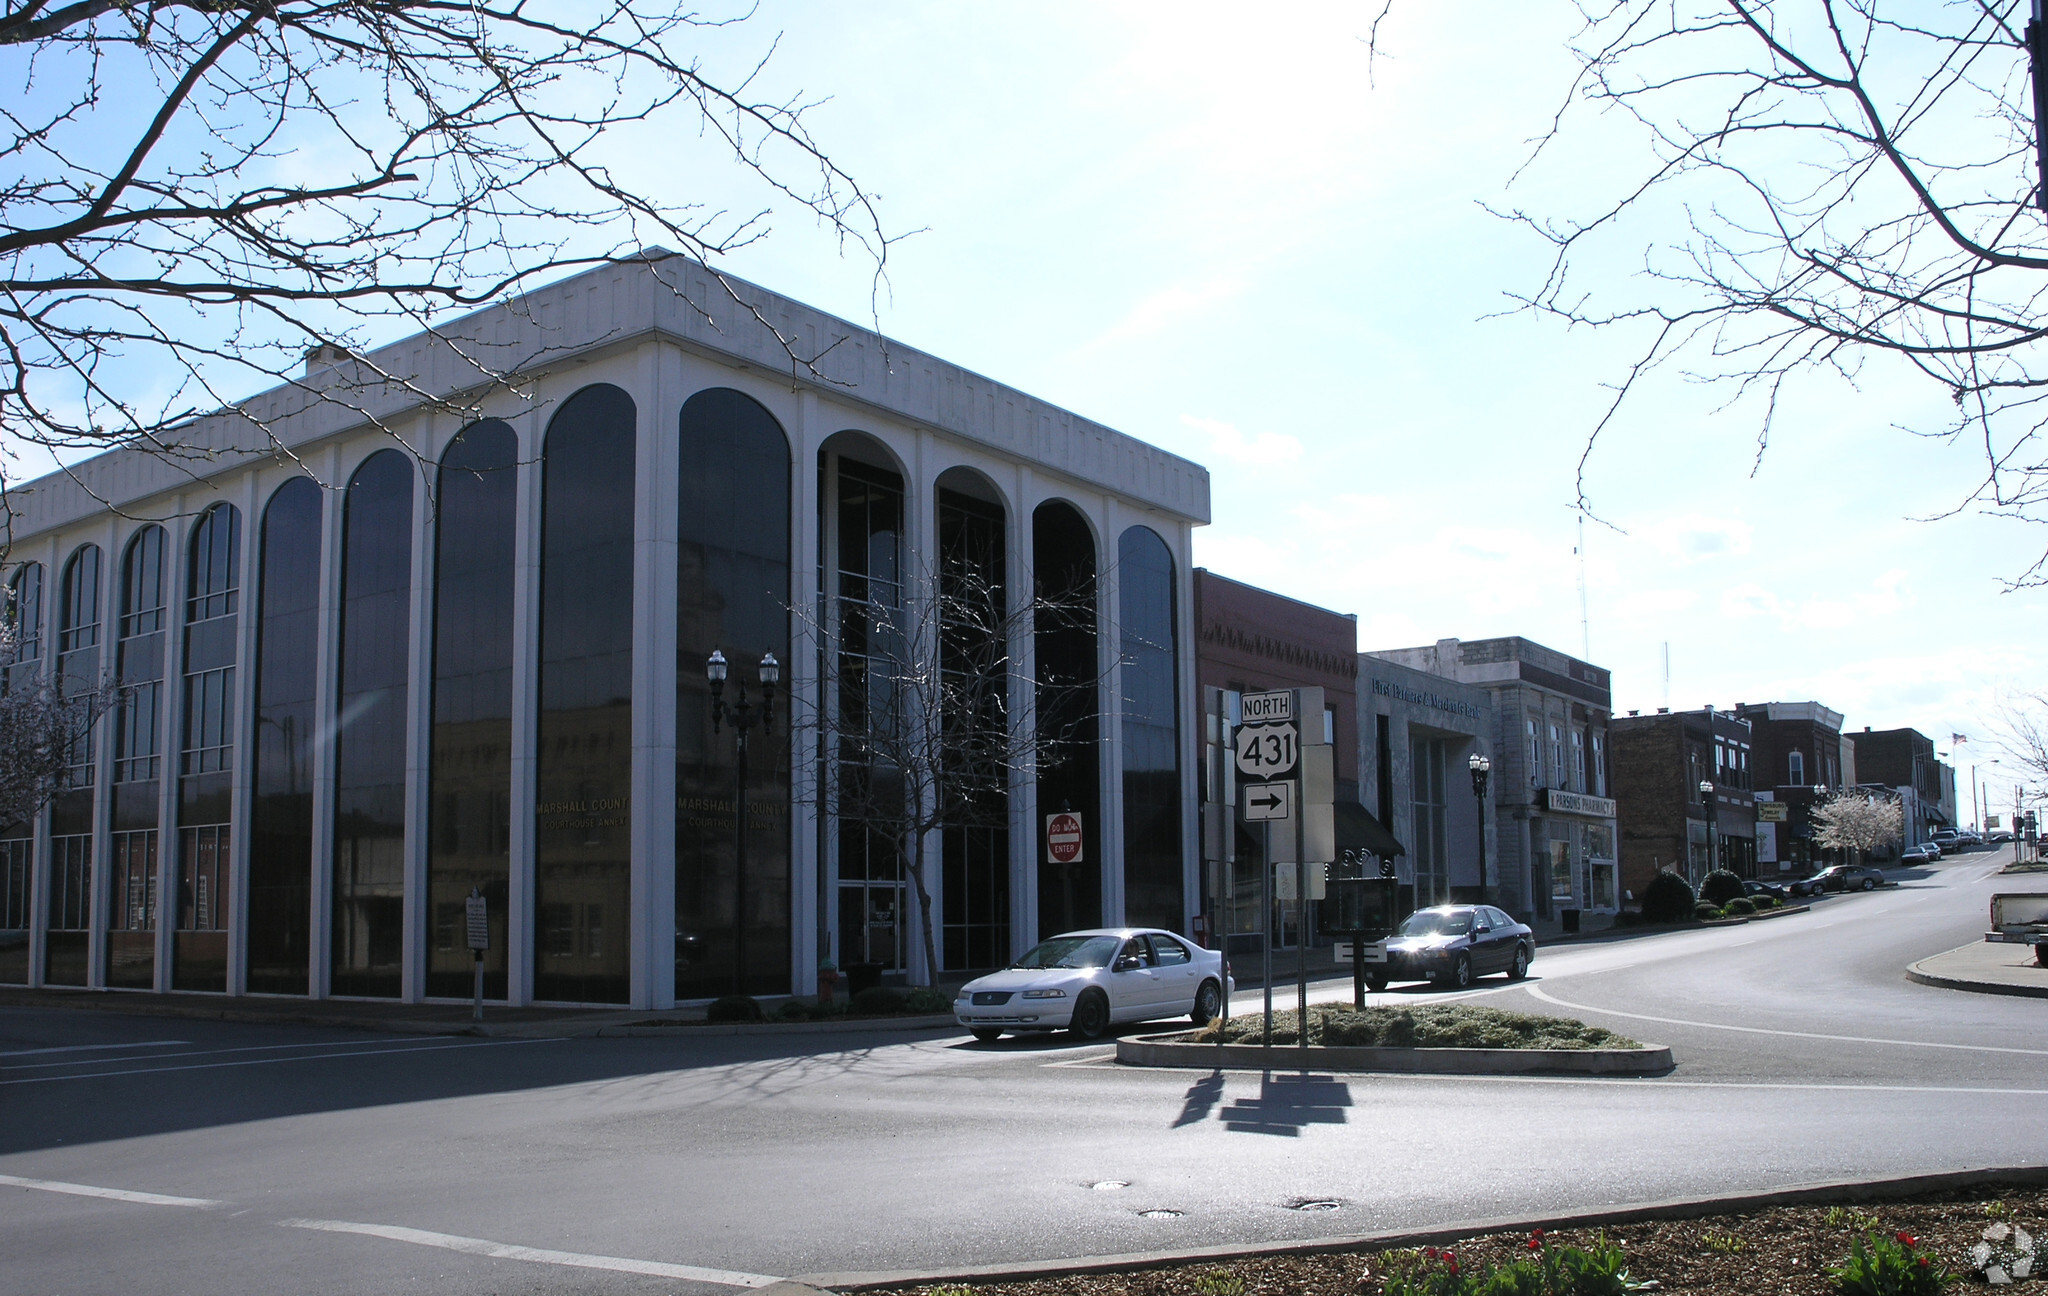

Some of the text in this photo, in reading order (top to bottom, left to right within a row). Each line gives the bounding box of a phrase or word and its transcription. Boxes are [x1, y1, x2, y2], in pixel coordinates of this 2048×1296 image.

[1244, 698, 1288, 715] NORTH
[1242, 733, 1290, 766] 431
[537, 801, 587, 815] MARSHALL
[677, 797, 738, 812] MARSHALL
[1556, 793, 1611, 815] PARSONS PHARMACY
[544, 815, 625, 830] COURTHOUSE ANNEX
[688, 816, 737, 829] COURTHOU
[1051, 824, 1061, 833] DO
[1054, 844, 1075, 854] ENTER
